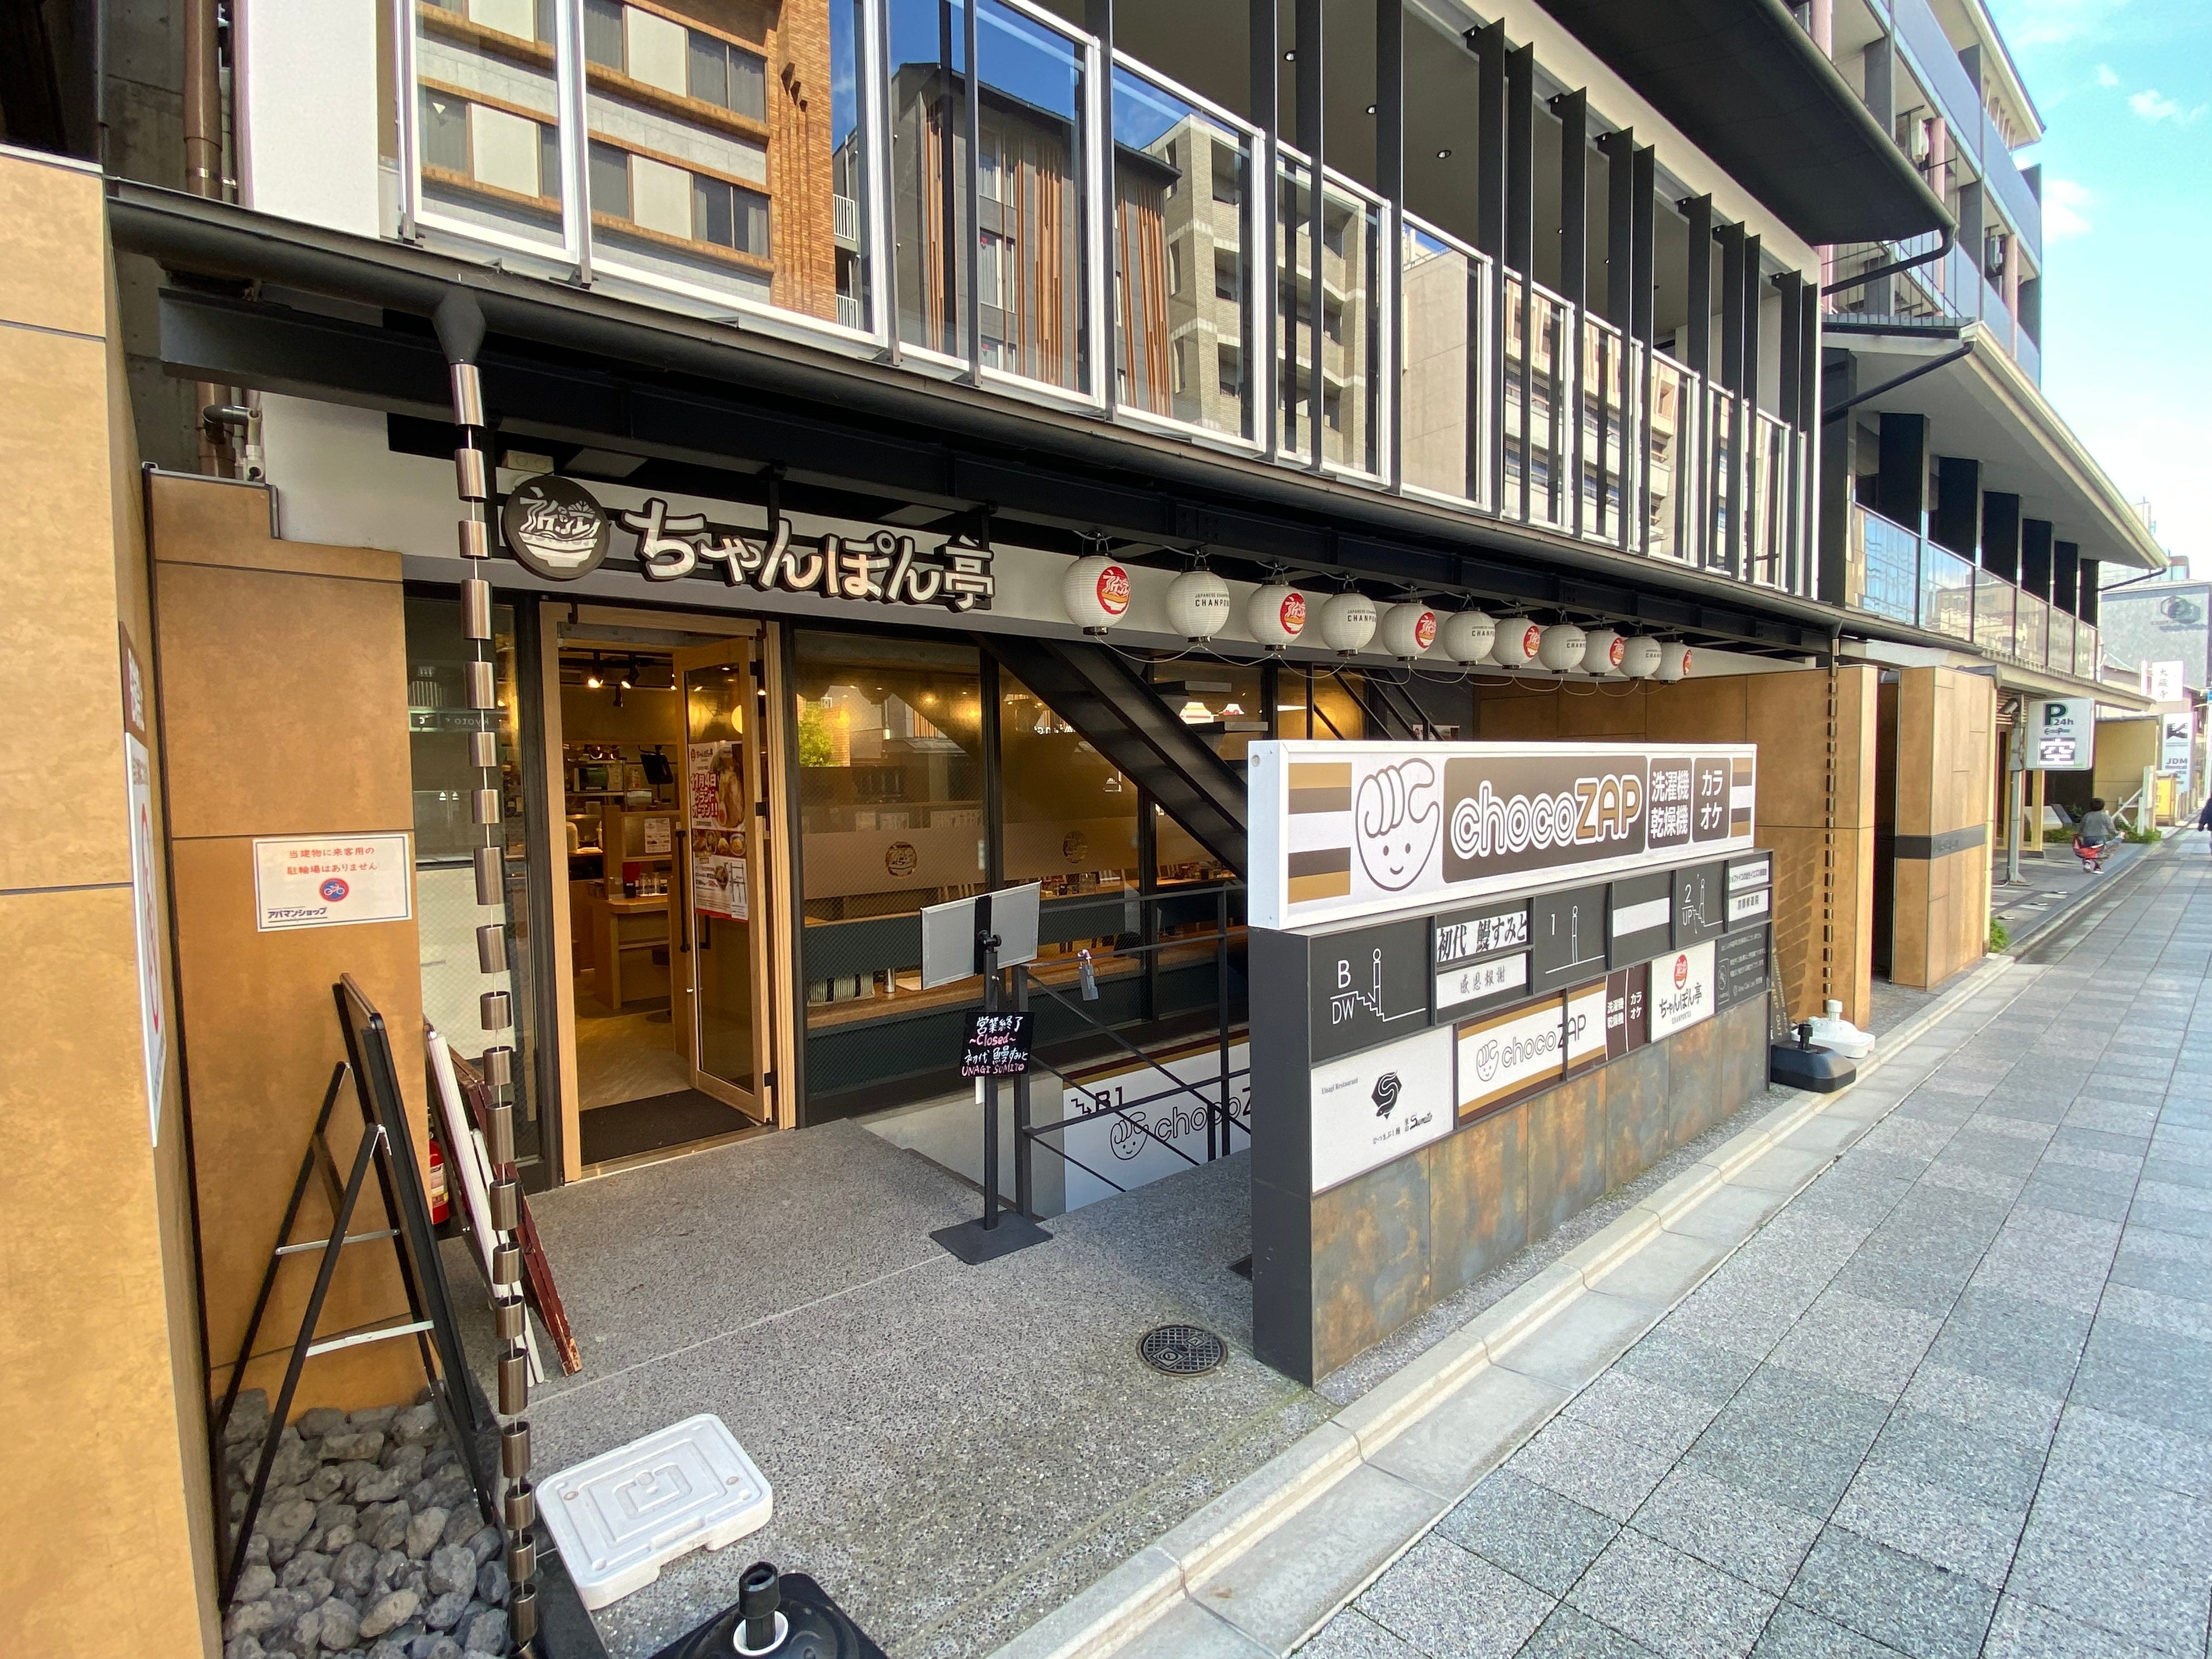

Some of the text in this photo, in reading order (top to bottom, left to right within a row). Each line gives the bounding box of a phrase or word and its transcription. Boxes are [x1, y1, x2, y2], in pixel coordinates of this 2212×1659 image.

[623, 497, 995, 614] ちゃんぽん亭
[2044, 704, 2066, 725] P
[2038, 737, 2076, 766] 空
[1651, 770, 1690, 802] 洗濯機
[1701, 769, 1723, 796] カラ
[1450, 774, 1643, 860] chocoZAP
[1650, 804, 1688, 839] 乾燥機
[1700, 801, 1723, 830] オケ
[289, 847, 375, 859] 当建物に来客用の
[286, 862, 378, 875] 駐輪場はありません
[1685, 884, 1692, 904] 2
[267, 907, 327, 919] アパマンショップ
[1437, 913, 1527, 963] 初代 鰻すみと
[1338, 960, 1352, 989] B
[1332, 997, 1355, 1025] DW
[1659, 982, 1702, 1019] ちゃんぽん亭
[976, 1015, 1023, 1035] 営業終了
[961, 1063, 1025, 1077] UNAGI SUMITO
[964, 1049, 990, 1066] 初代
